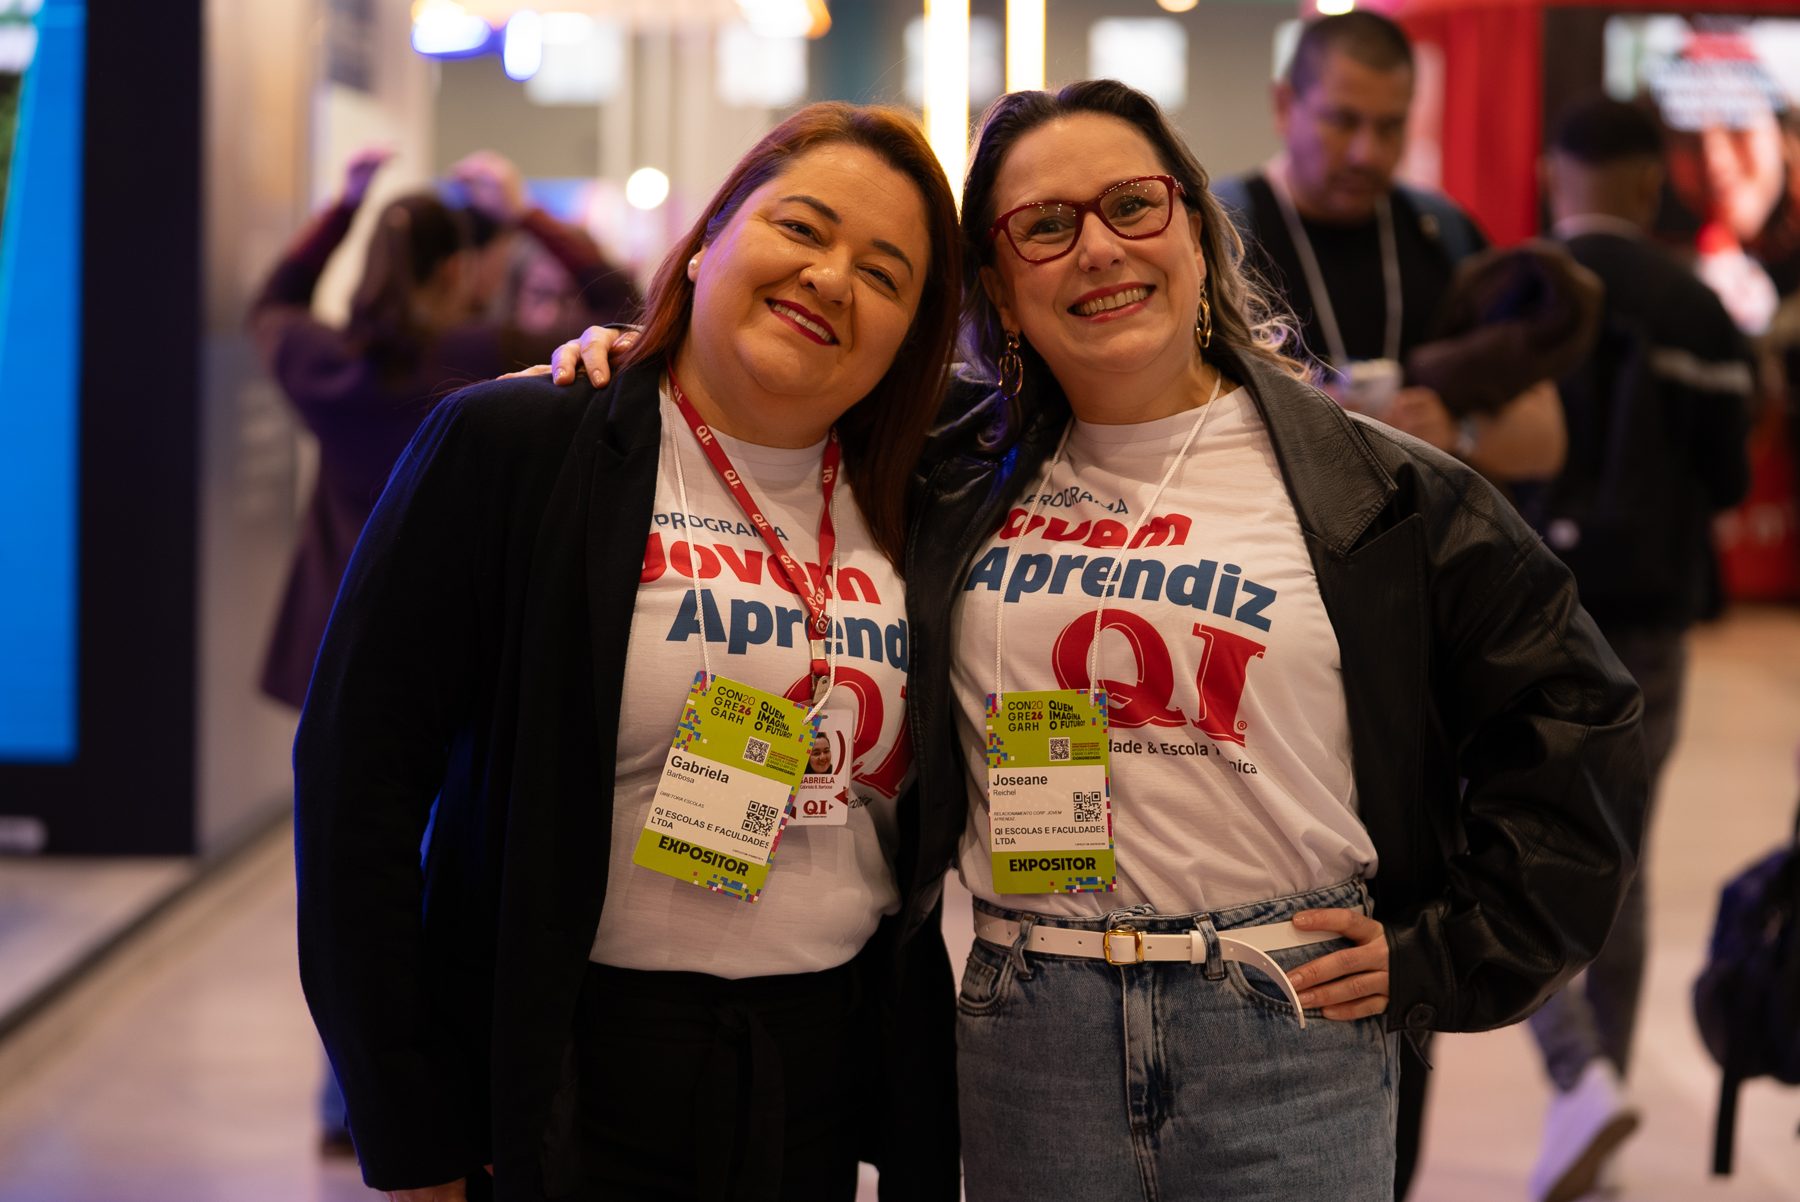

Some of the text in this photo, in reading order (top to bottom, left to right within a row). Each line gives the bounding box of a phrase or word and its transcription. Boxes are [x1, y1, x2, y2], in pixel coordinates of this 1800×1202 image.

[1023, 486, 1129, 515] PROGRAA
[1000, 508, 1193, 550] ovem
[963, 546, 1278, 633] Aprendiz
[761, 701, 785, 720] QUEM
[1049, 700, 1073, 712] QUEM
[711, 706, 745, 725] GARH
[757, 710, 790, 731] IMAGINA
[1049, 711, 1081, 720] IMAGINA
[754, 721, 763, 731] O
[1008, 722, 1039, 732] GARH
[1049, 721, 1057, 730] O
[1147, 741, 1158, 754] &
[1159, 742, 1208, 756] Escola
[666, 769, 695, 784] Barbosa
[670, 755, 730, 784] Gabriela
[992, 774, 1048, 786] Joseane
[993, 788, 1016, 796] Reichel
[803, 800, 828, 815] QI
[651, 816, 674, 830] LTDA
[654, 807, 664, 816] QI
[665, 809, 705, 829] ESCOLAS
[707, 823, 713, 831] E
[994, 827, 1003, 836] QI
[1005, 827, 1042, 835] ESCOLAS
[1045, 826, 1050, 834] E
[995, 837, 1016, 845] LTDA
[658, 835, 749, 877] EXPOSITOR
[1009, 857, 1096, 872] EXPOSITOR
